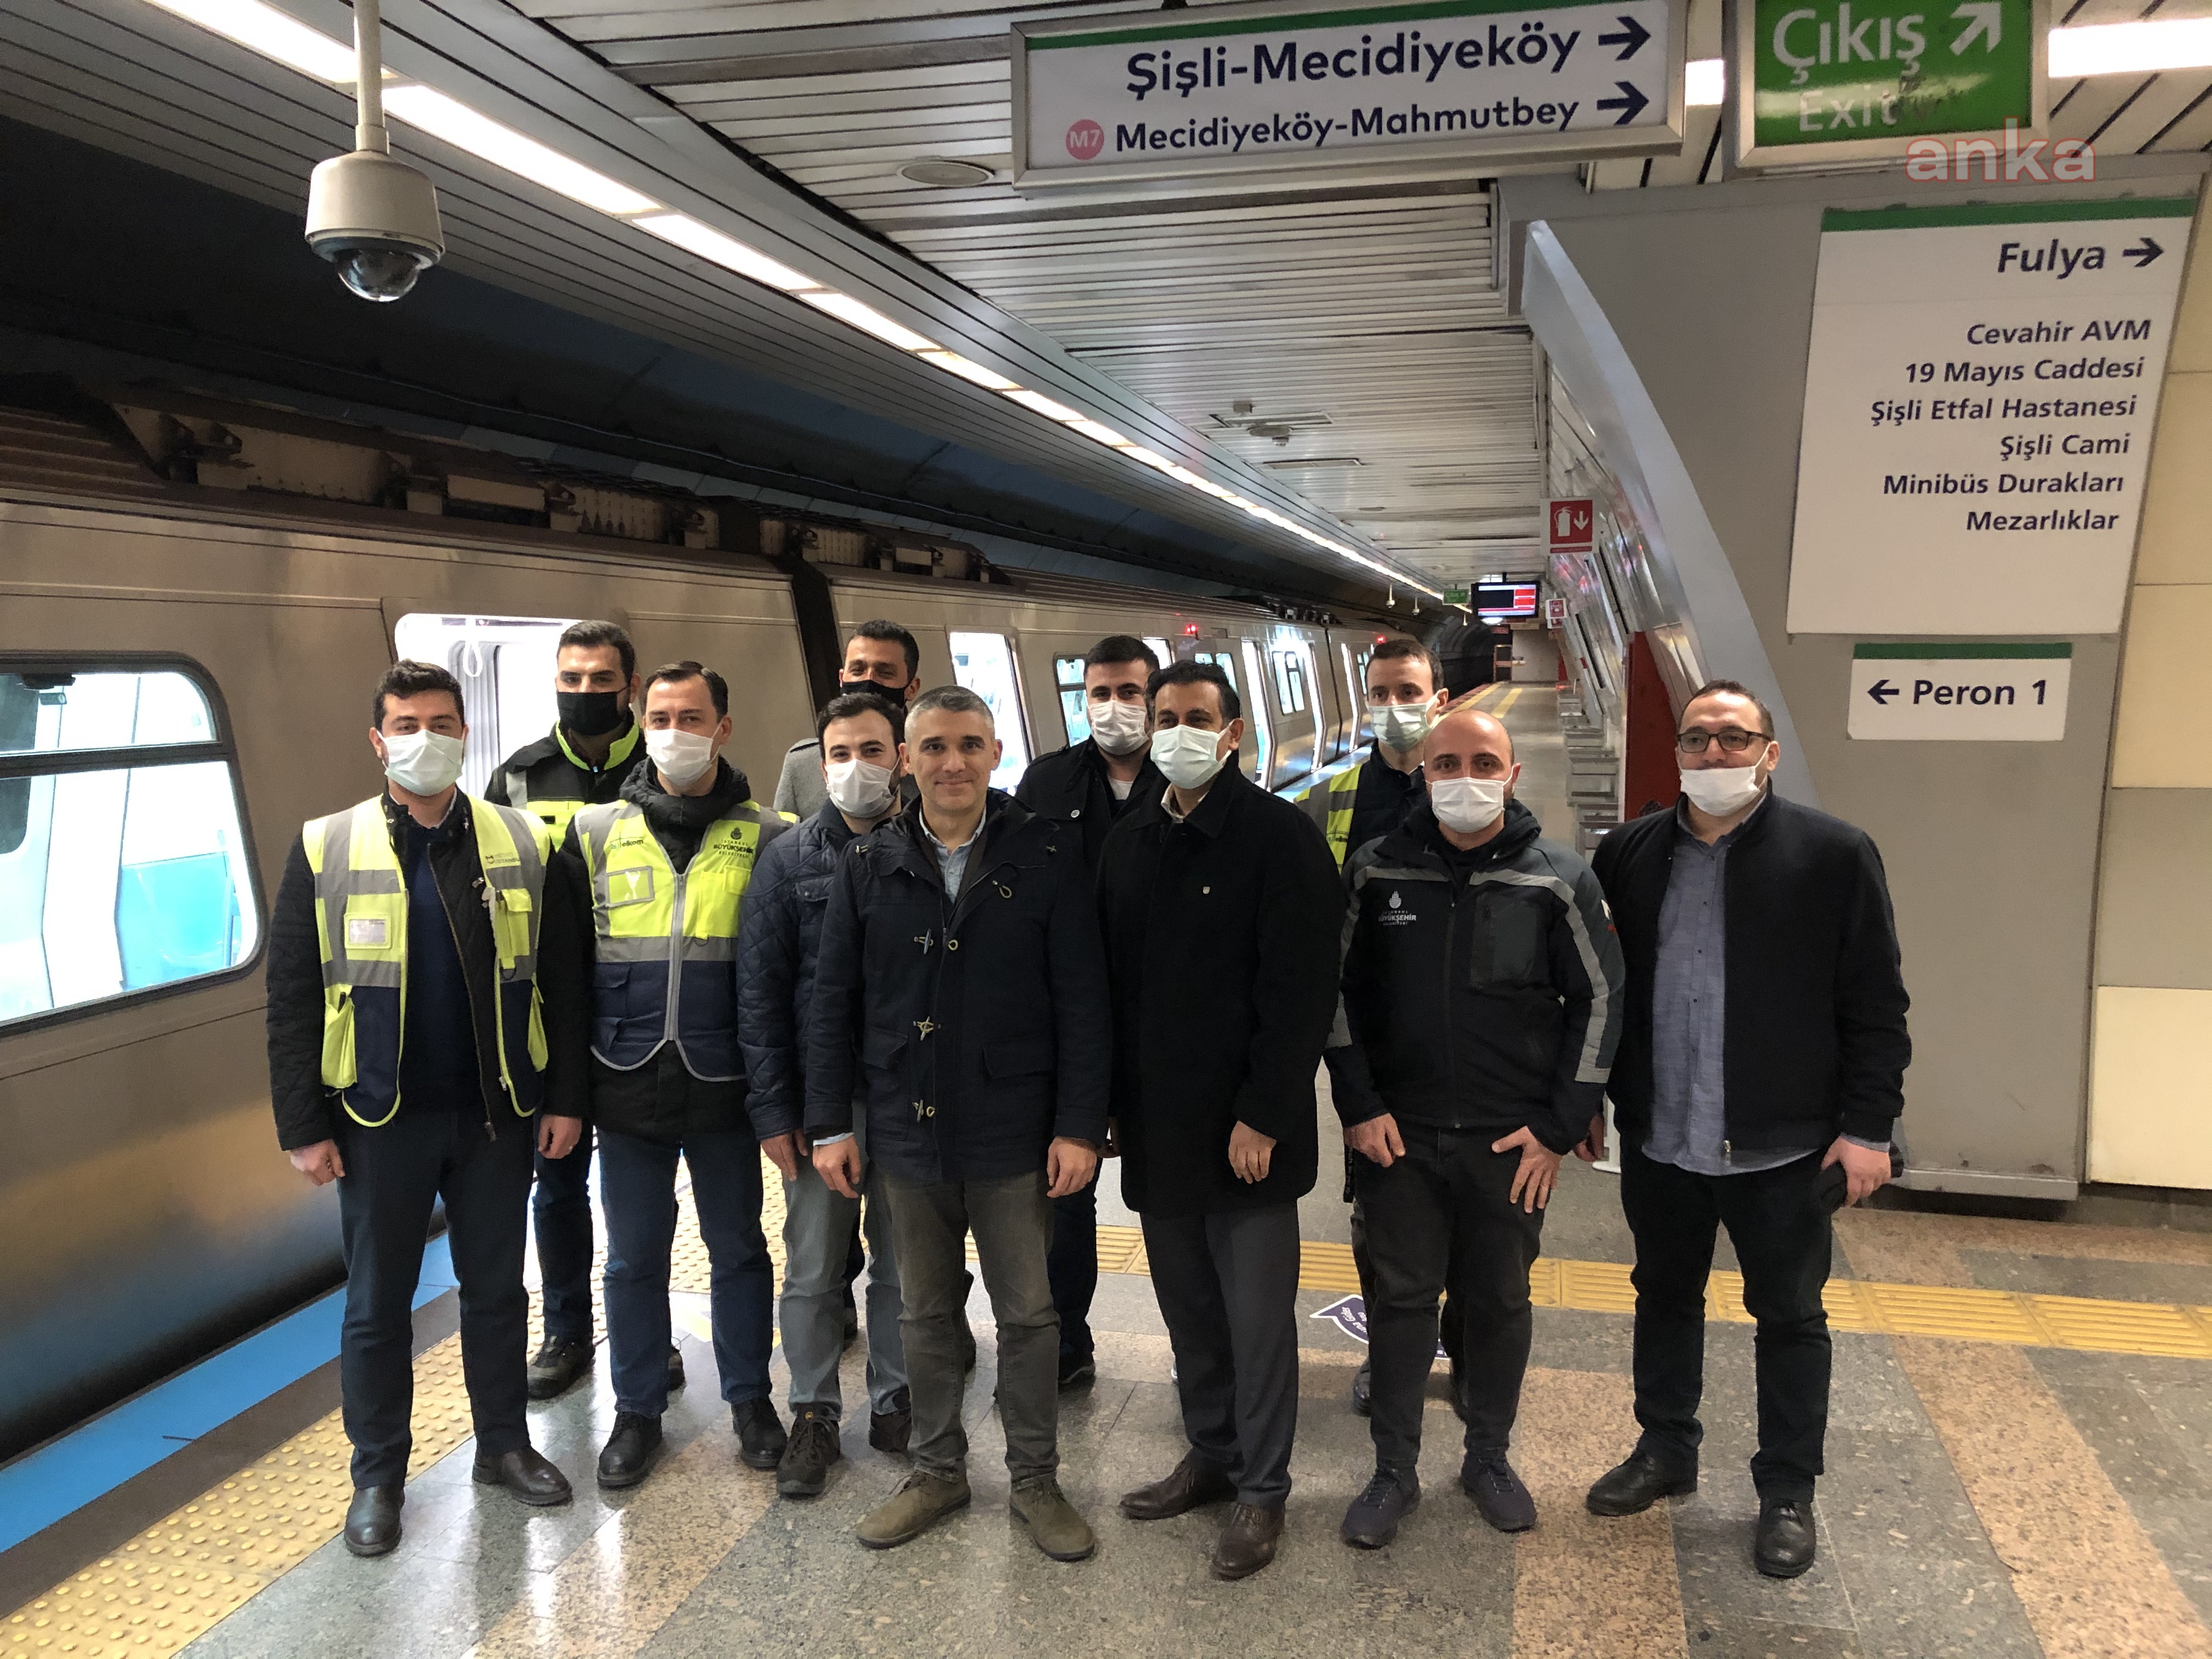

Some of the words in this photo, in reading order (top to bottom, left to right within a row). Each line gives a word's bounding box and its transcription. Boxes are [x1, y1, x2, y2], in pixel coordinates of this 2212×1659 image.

[1773, 2, 1925, 85] Çıkış
[1126, 21, 1581, 100] Şişli-Mecidiyeköy
[1799, 84, 1898, 132] Exit
[1070, 129, 1100, 148] M7
[1116, 98, 1579, 154] Mecidiyeköy-Mahmutbey
[1997, 239, 2105, 280] Fulya
[1967, 320, 2074, 345] Cevahir
[2080, 319, 2152, 341] AVM
[1906, 363, 1934, 383] 19
[1944, 362, 2024, 387] Mayıs
[2034, 357, 2145, 380] Caddesi
[1871, 399, 1922, 426] Şişli
[1931, 398, 1993, 420] Etfal
[2002, 394, 2137, 419] Hastanesi
[2000, 434, 2052, 461] Şişli
[2062, 433, 2130, 455] Cami
[1883, 473, 1988, 494] Minibüs
[1998, 471, 2124, 493] Durakları
[1966, 509, 2119, 531] Mezarlıklar
[1913, 680, 2015, 705] Peron
[2032, 680, 2046, 705] 1
